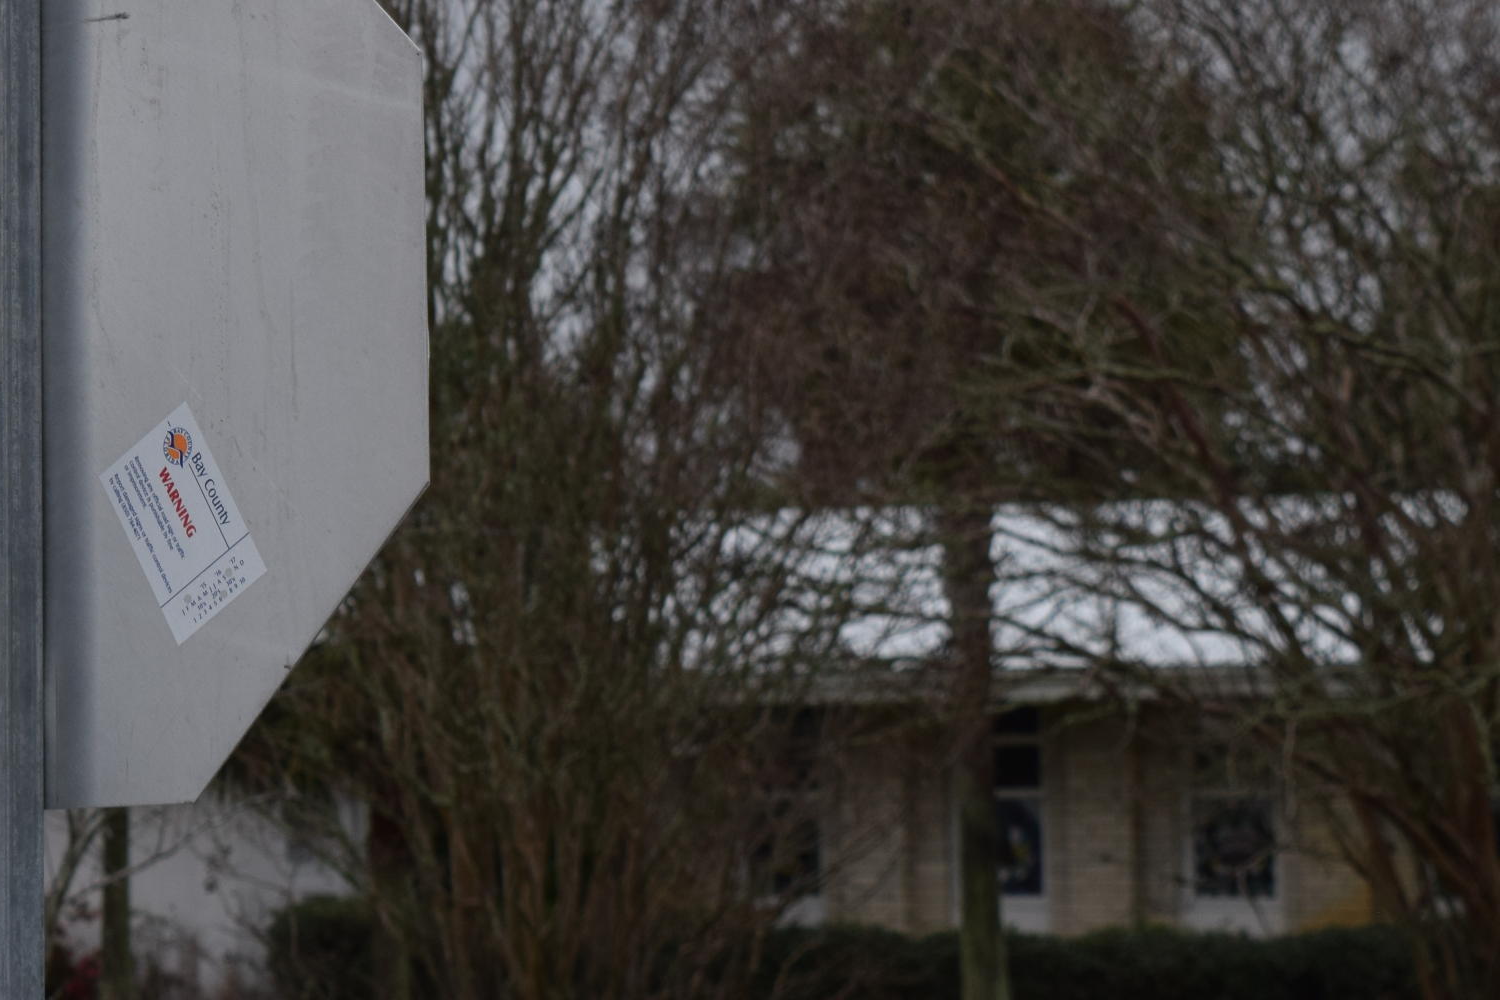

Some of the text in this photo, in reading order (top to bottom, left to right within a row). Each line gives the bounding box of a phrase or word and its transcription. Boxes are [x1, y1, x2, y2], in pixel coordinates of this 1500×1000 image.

[159, 467, 197, 538] WARNING
[192, 452, 231, 525] Bay County
